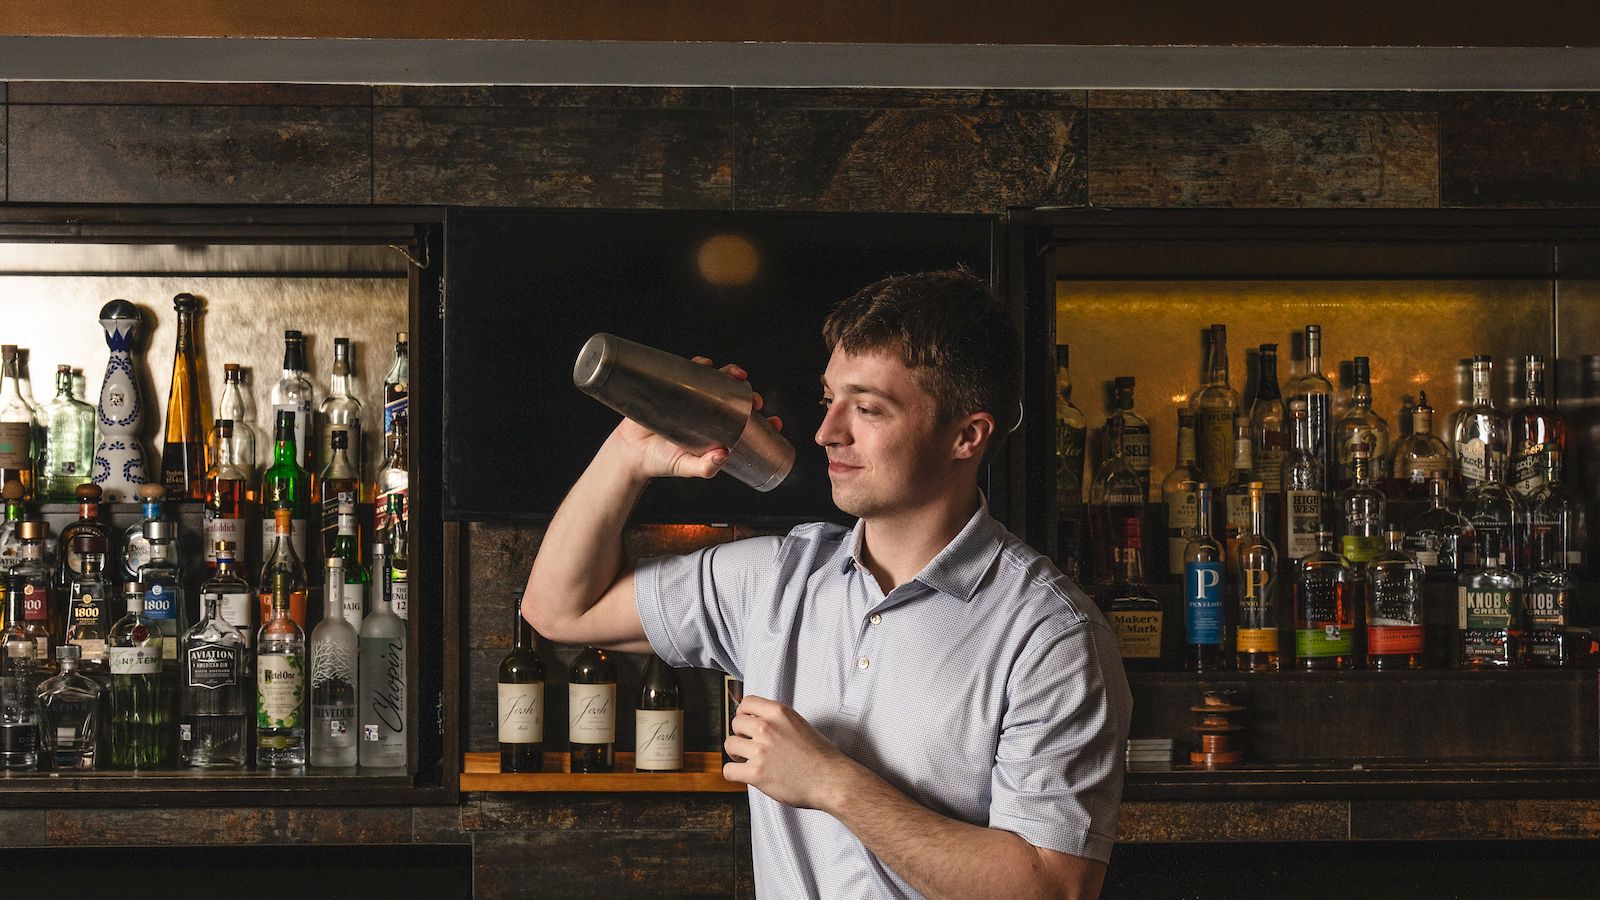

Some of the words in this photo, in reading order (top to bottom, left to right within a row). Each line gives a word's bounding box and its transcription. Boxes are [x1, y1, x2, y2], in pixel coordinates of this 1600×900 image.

[1125, 444, 1150, 457] SELL
[1292, 495, 1319, 505] HIGH
[1195, 568, 1220, 600] P
[1244, 568, 1269, 600] P
[144, 600, 170, 611] 1800
[396, 601, 407, 611] 12
[1467, 592, 1502, 609] KNOB
[1522, 593, 1554, 610] KNOB
[74, 607, 100, 618] 1800
[1114, 615, 1160, 624] Maker's
[1126, 625, 1158, 634] Mark
[136, 656, 158, 665] TEN
[190, 650, 235, 660] AVIATION
[264, 669, 283, 684] Ketel
[282, 671, 296, 680] One
[372, 638, 405, 734] Chopin
[500, 693, 536, 728] Josh
[571, 693, 610, 728] Josh
[638, 720, 679, 754] Josh
